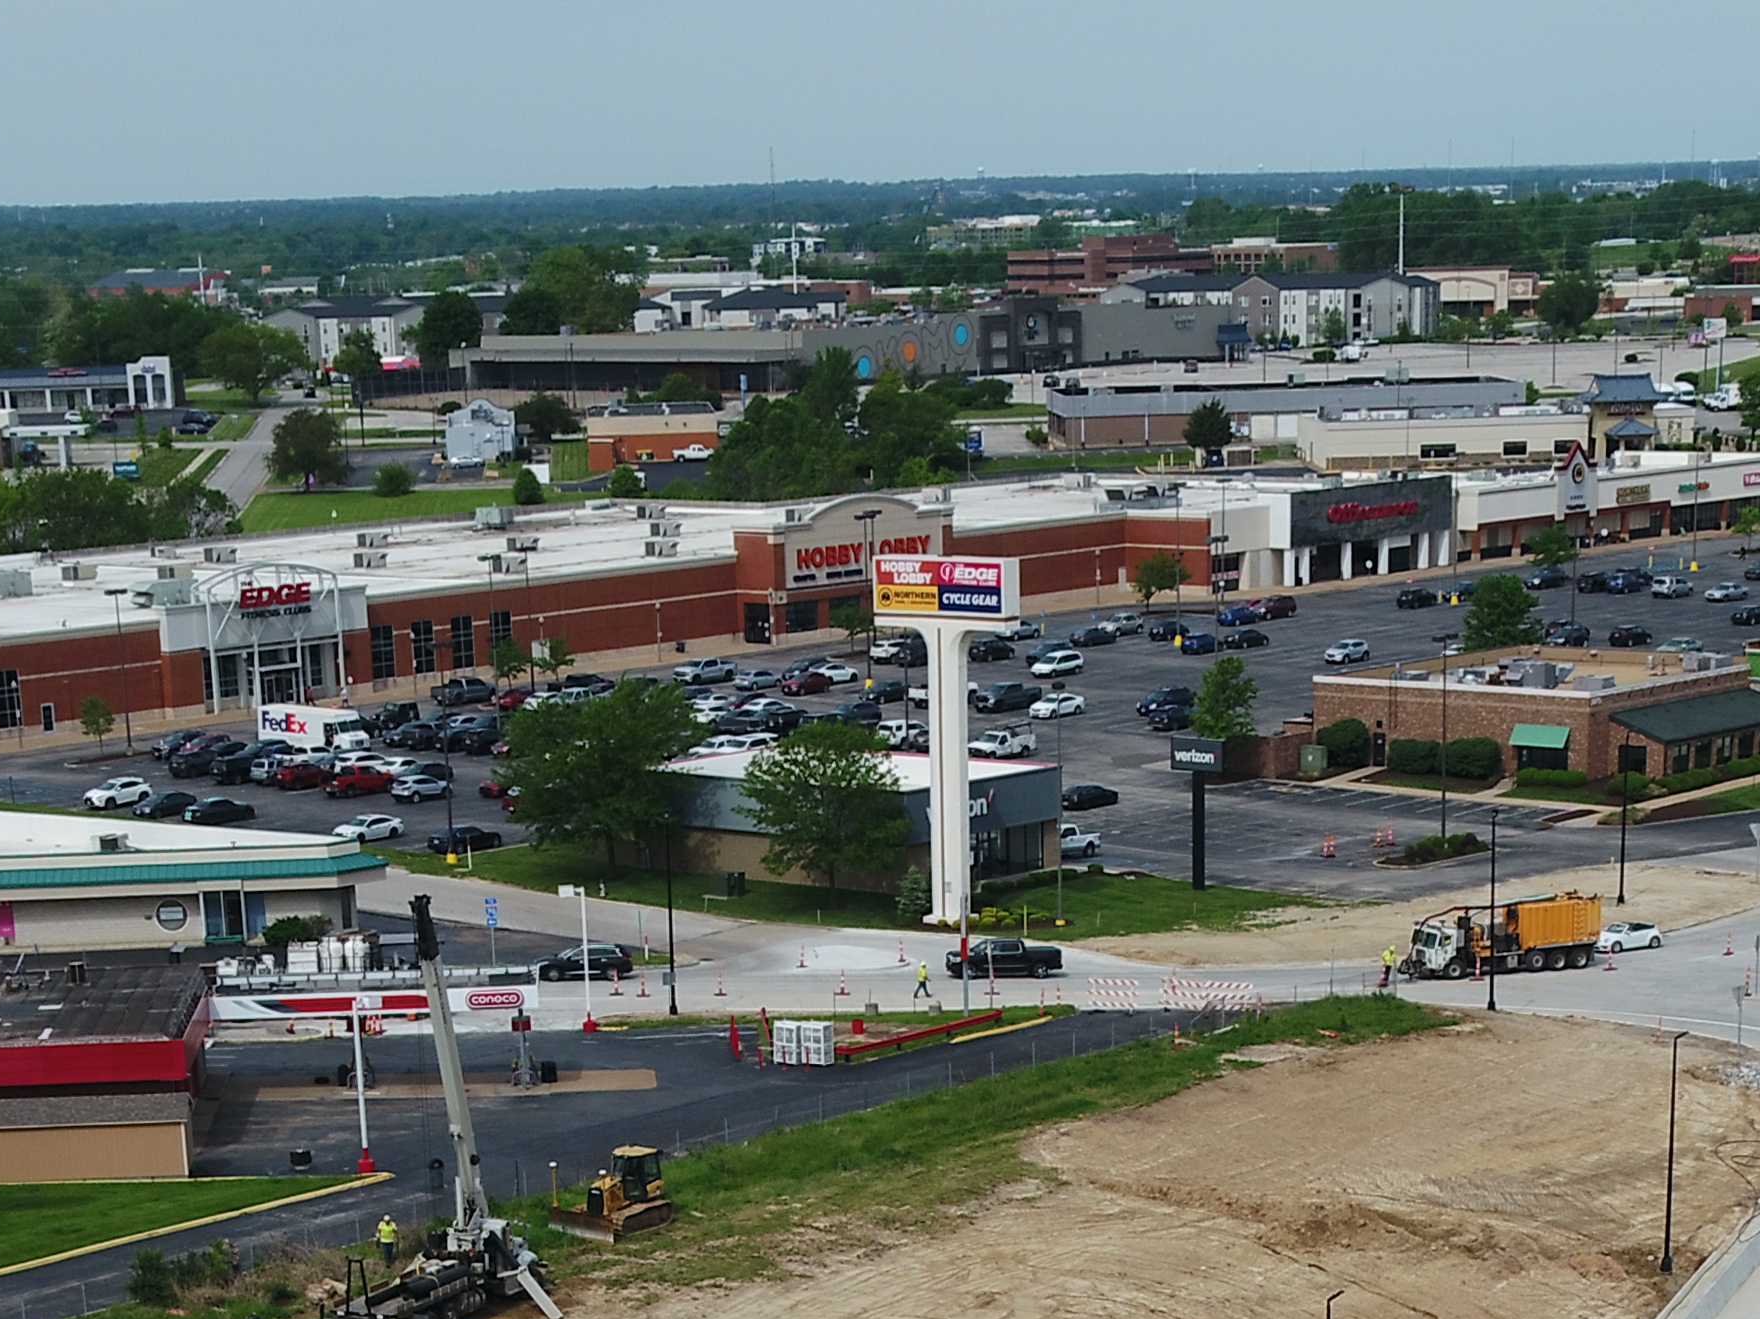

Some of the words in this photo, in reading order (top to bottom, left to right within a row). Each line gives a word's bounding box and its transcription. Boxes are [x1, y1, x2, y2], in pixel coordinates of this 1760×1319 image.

[796, 542, 864, 569] HOBBY
[880, 561, 922, 573] HOBBY
[953, 567, 999, 580] EDGE
[893, 572, 933, 584] LOBBY
[240, 582, 312, 609] EDGE
[894, 590, 938, 600] NORTHERN
[942, 592, 972, 605] CYCLE
[972, 593, 999, 607] GEAR
[241, 611, 281, 620] FITNESS
[261, 710, 308, 735] FedEx
[1174, 748, 1215, 764] verizon
[471, 994, 518, 1004] conoco
